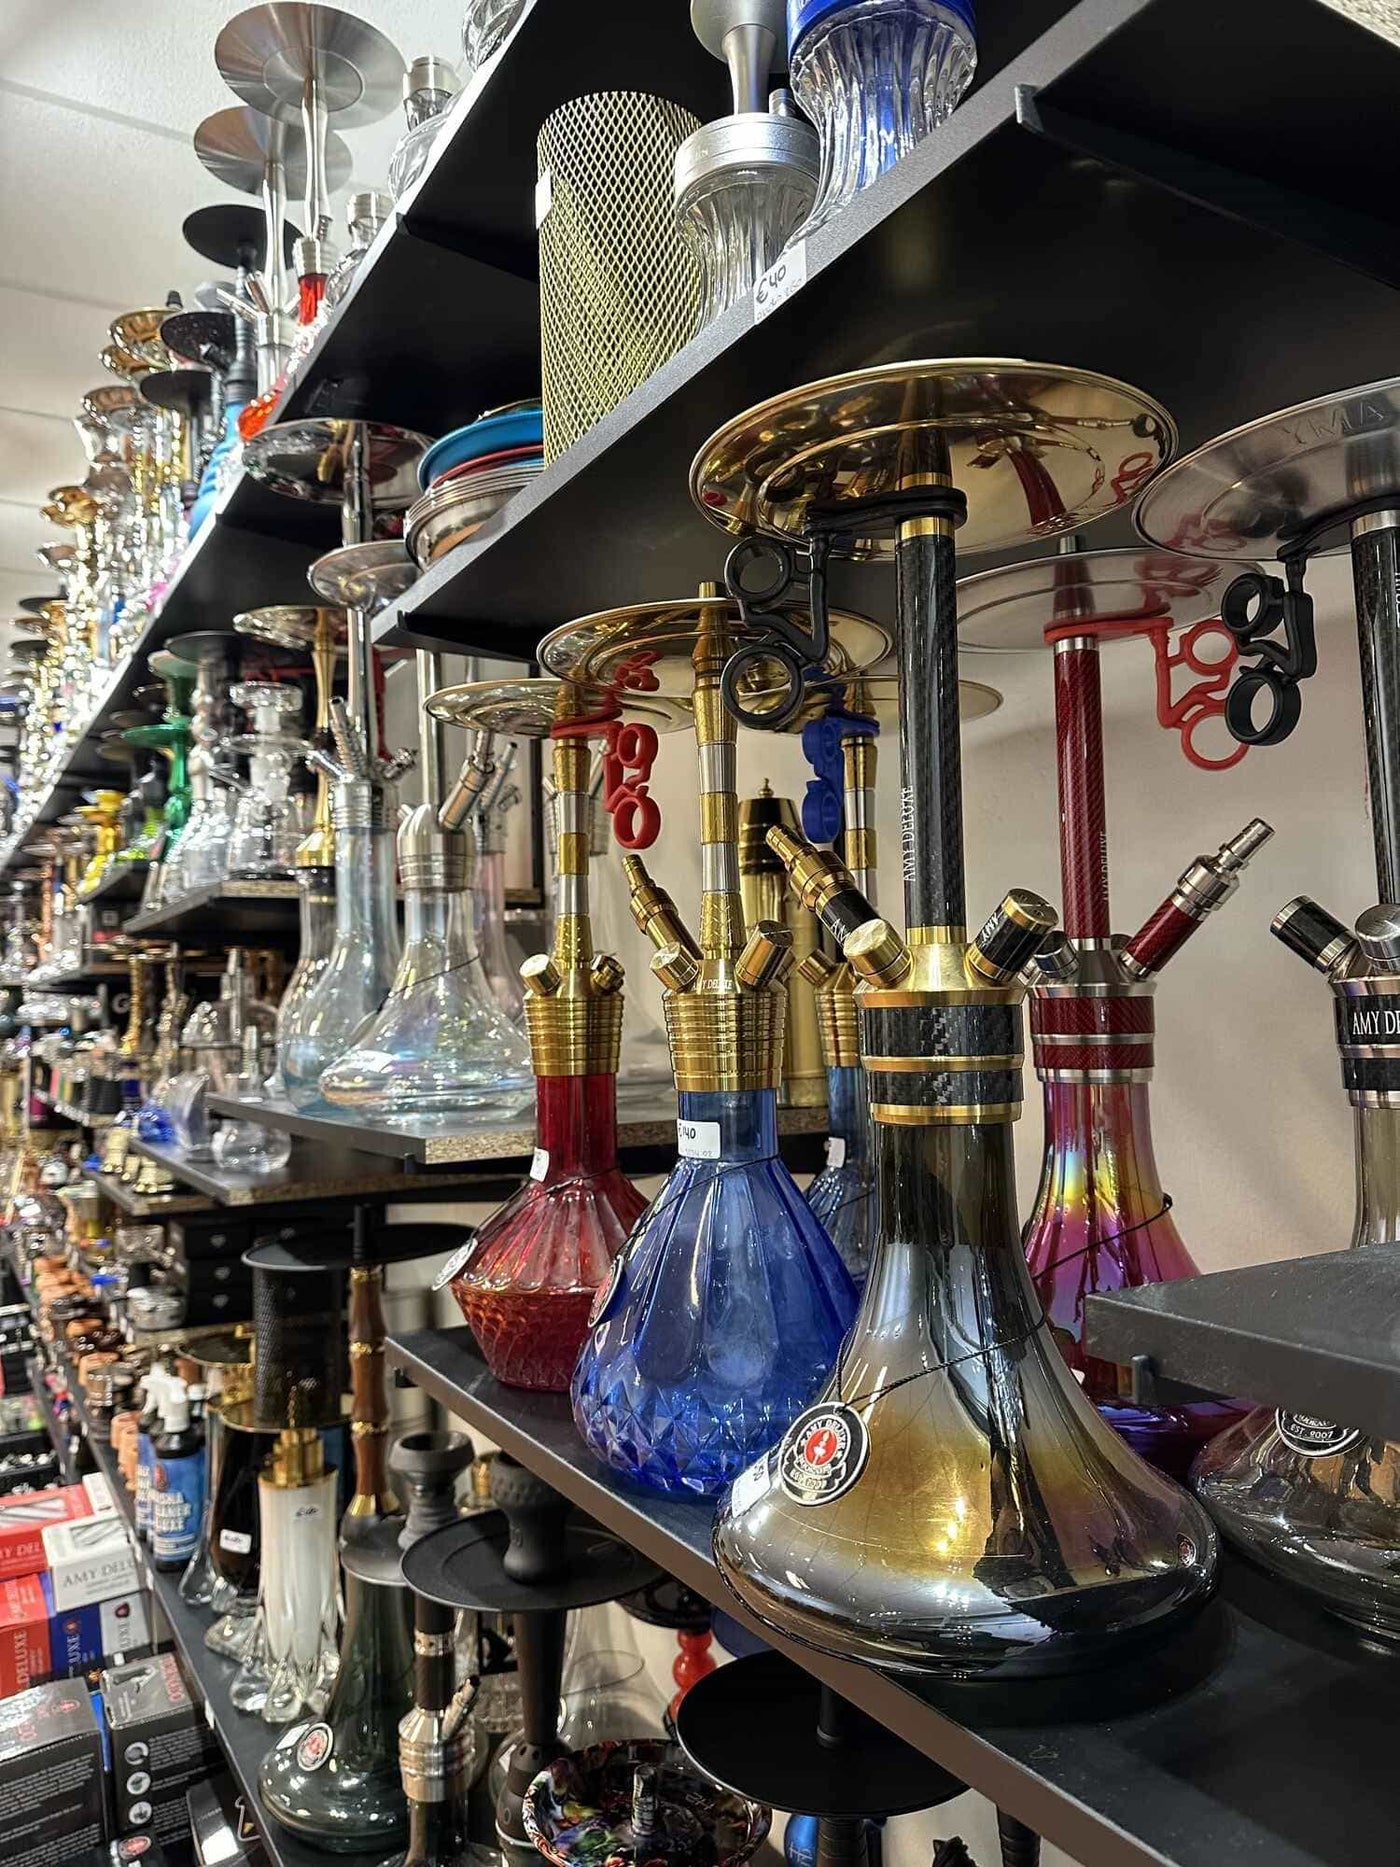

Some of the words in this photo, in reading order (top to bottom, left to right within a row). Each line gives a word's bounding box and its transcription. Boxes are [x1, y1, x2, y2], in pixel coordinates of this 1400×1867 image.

[901, 785, 915, 843] DELUXE
[902, 848, 916, 882] AMY
[1352, 1010, 1380, 1035] AMY
[64, 1568, 98, 1588] AMY
